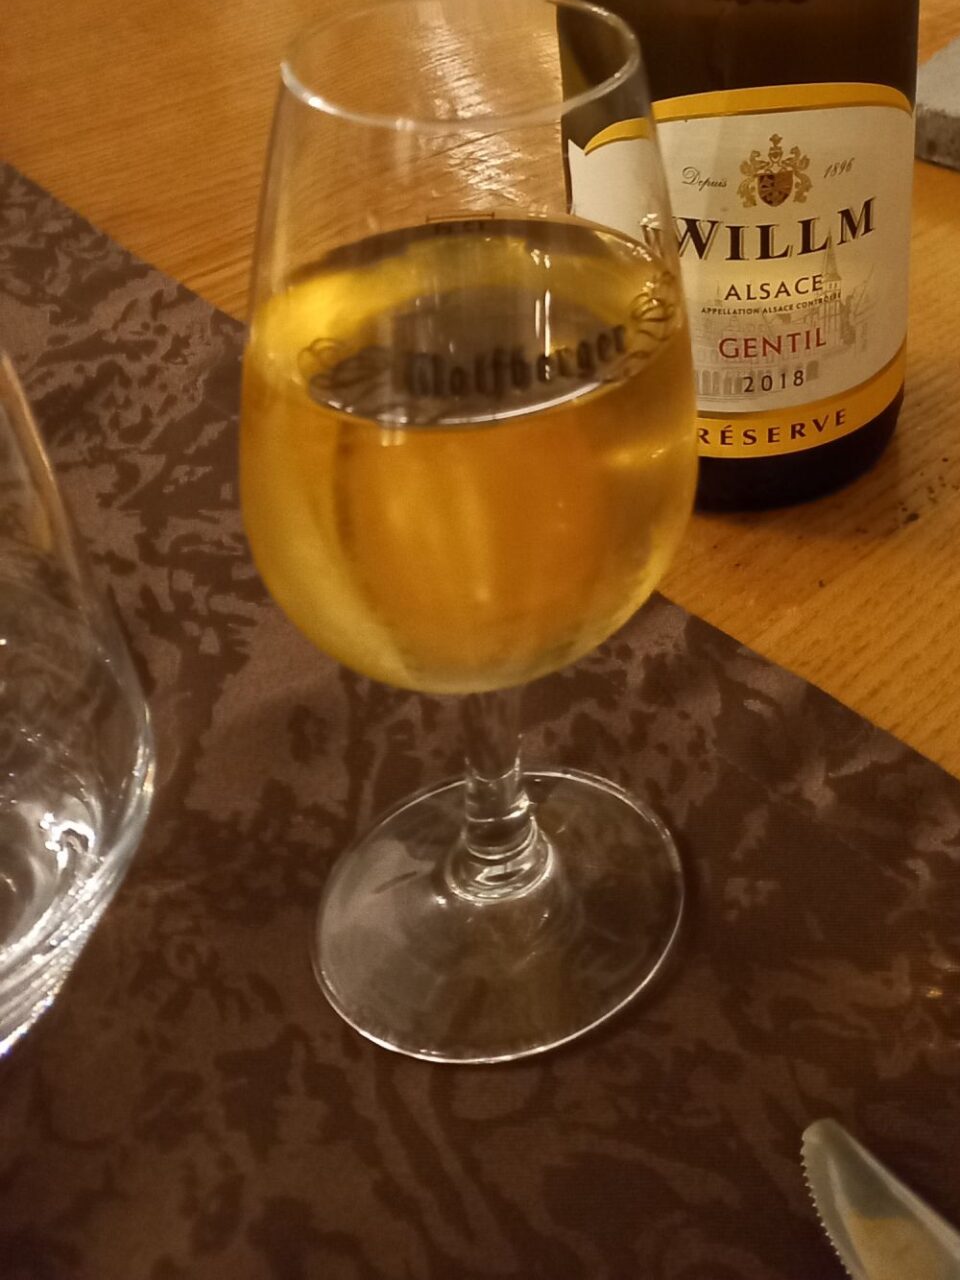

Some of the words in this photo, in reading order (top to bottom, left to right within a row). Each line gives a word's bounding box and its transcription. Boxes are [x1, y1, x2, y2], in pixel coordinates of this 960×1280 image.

[682, 166, 728, 192] Depuis
[823, 157, 856, 179] 1896
[672, 195, 876, 261] WILLM
[724, 273, 824, 301] ALSACE
[701, 306, 760, 316] APPELLATION
[762, 303, 794, 315] ALSACE
[719, 327, 828, 359] GENTIL
[743, 370, 805, 393] 2018
[697, 408, 847, 447] RÉSERVE
